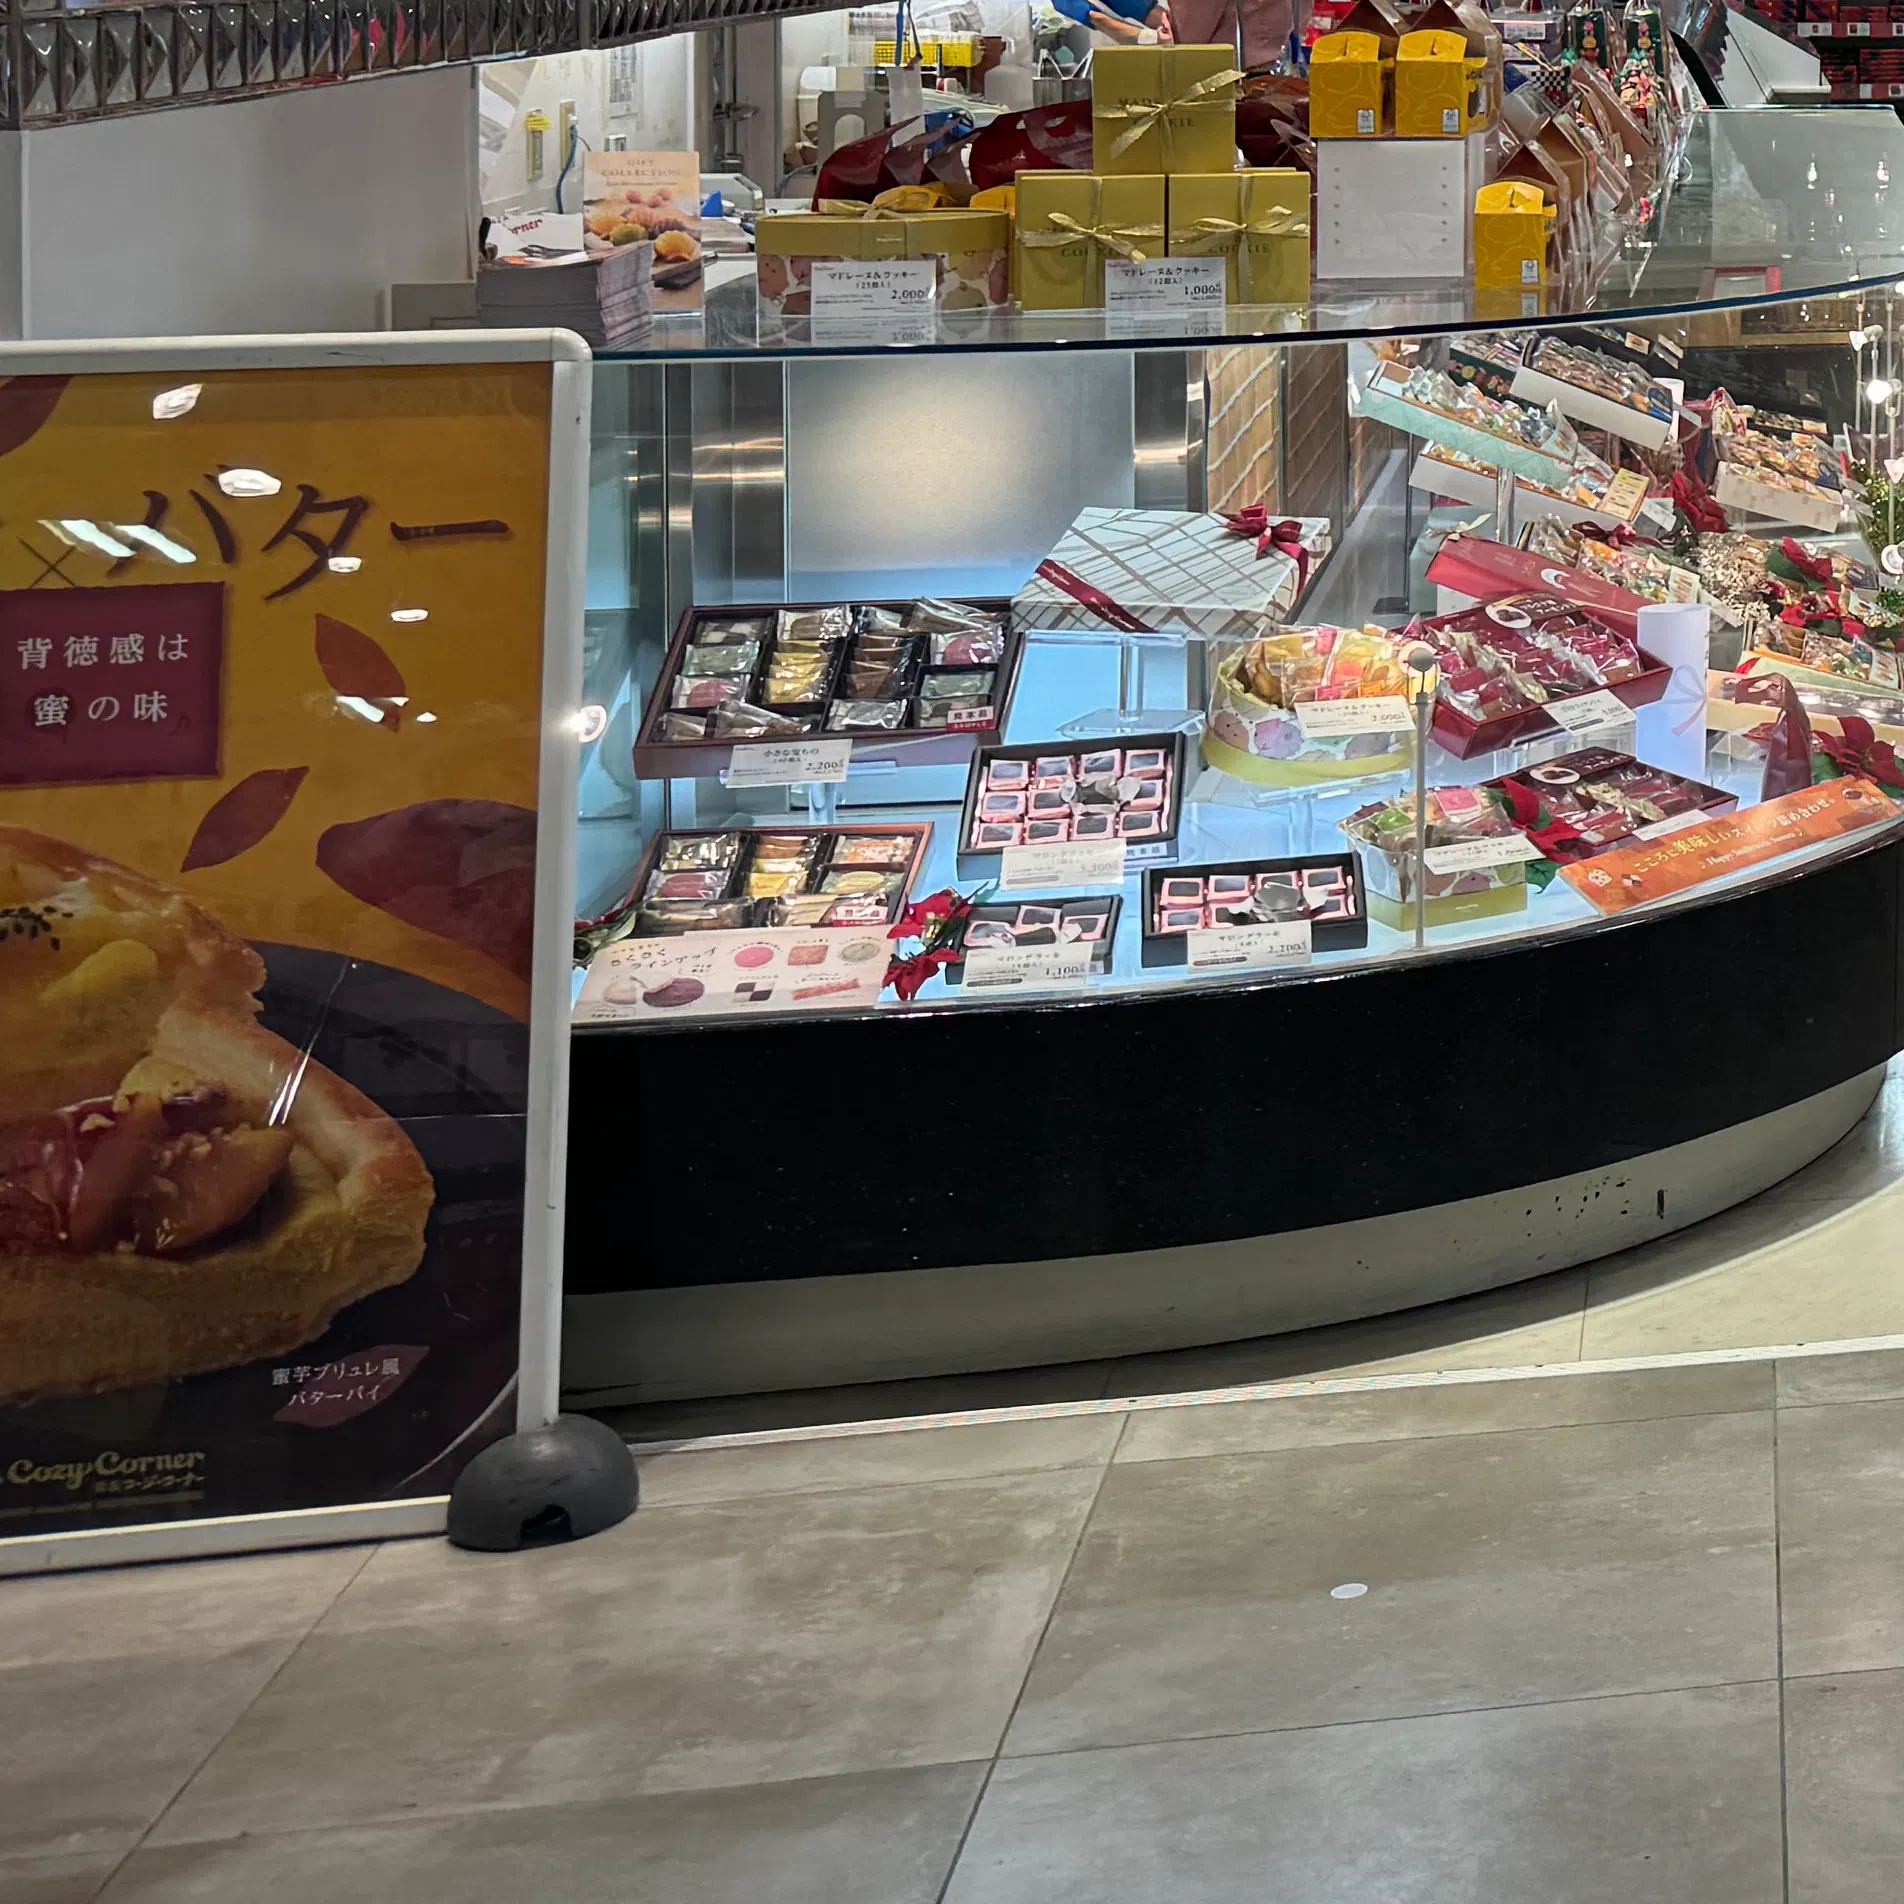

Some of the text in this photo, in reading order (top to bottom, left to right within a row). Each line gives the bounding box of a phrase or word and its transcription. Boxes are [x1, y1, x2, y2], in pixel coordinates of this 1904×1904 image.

[17, 633, 189, 670] 背徳感は
[34, 691, 168, 726] 蜜の味
[271, 1357, 400, 1387] 蜜芋ブリュレ風
[288, 1384, 381, 1407] バターパイ
[7, 1451, 206, 1490] Cozy Corner
